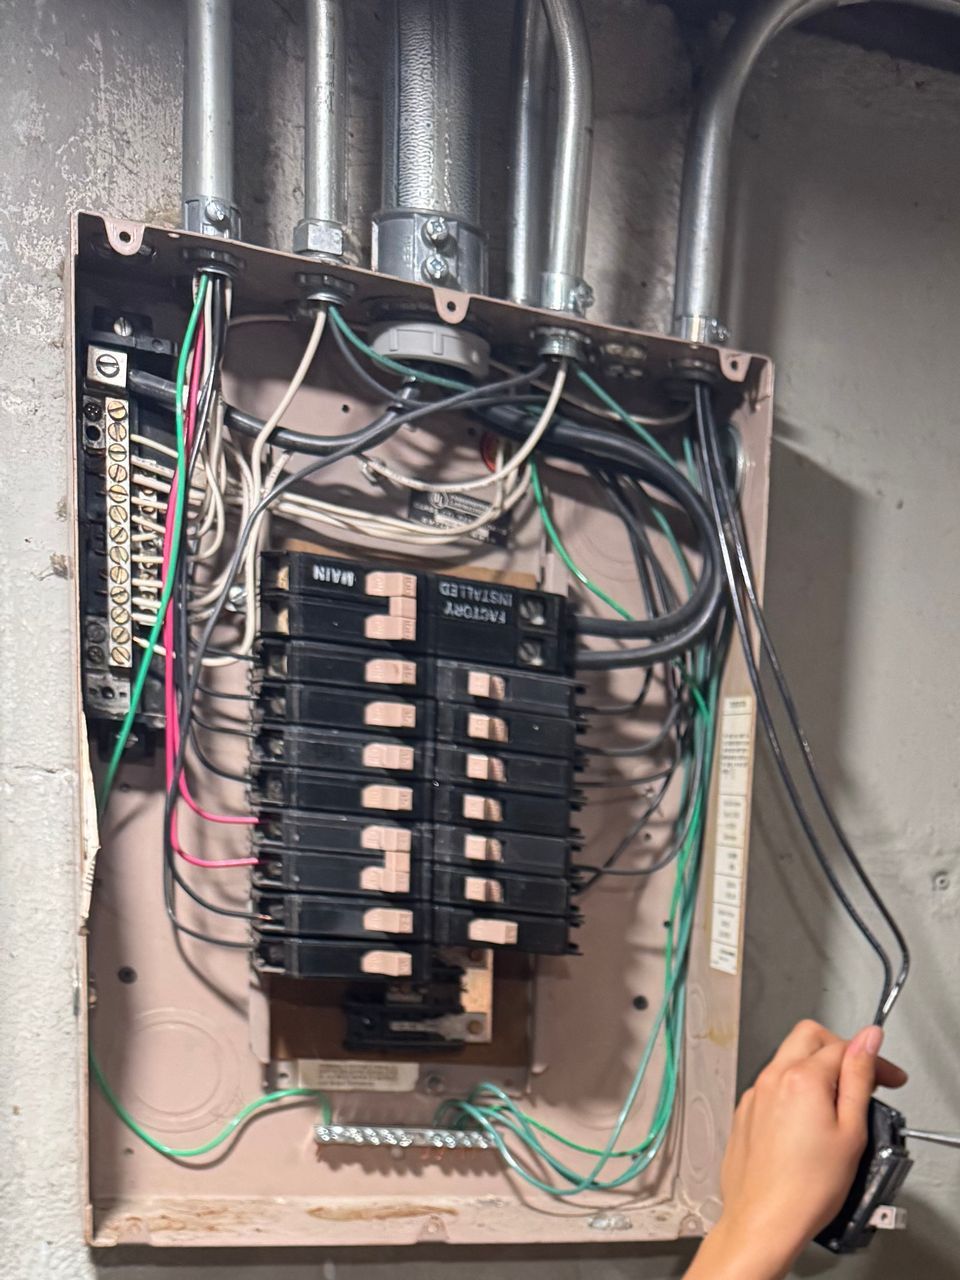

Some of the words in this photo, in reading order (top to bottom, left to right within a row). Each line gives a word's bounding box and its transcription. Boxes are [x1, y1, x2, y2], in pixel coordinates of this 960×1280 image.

[312, 565, 355, 587] MAIN
[439, 582, 513, 607] INSTALLED
[443, 601, 506, 624] FACTORY
